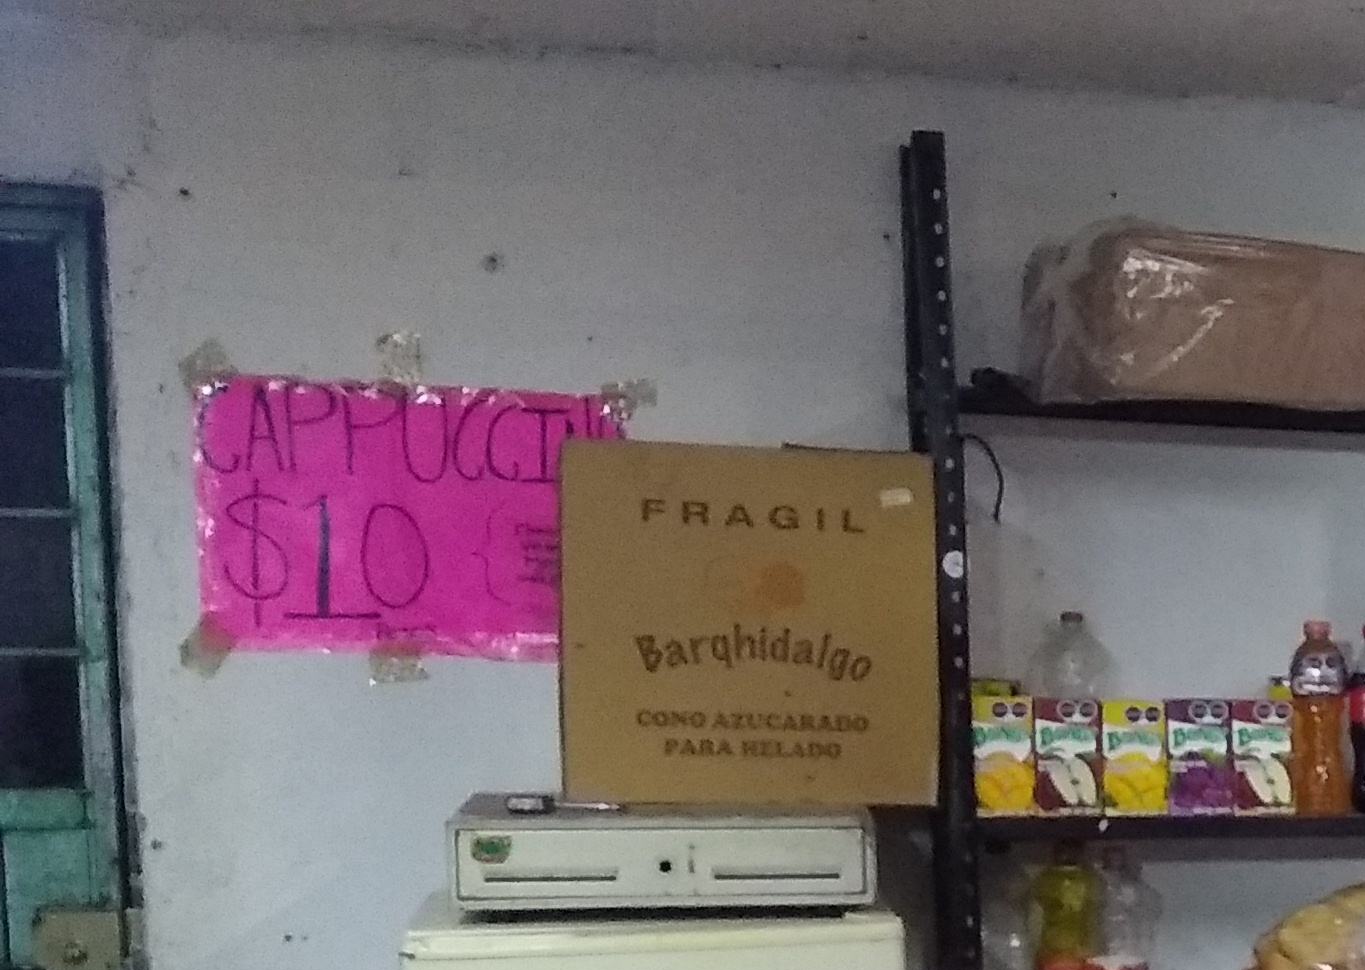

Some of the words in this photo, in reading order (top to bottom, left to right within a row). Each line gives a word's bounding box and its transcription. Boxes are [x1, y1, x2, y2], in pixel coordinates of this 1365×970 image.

[198, 384, 627, 483] CAPPUCCI
[641, 499, 865, 533] FRAGIL
[222, 478, 430, 627] $10
[636, 709, 706, 728] CONO
[711, 711, 869, 733] AZUCARADO
[664, 737, 734, 758] PARA
[741, 739, 842, 760] HELADO
